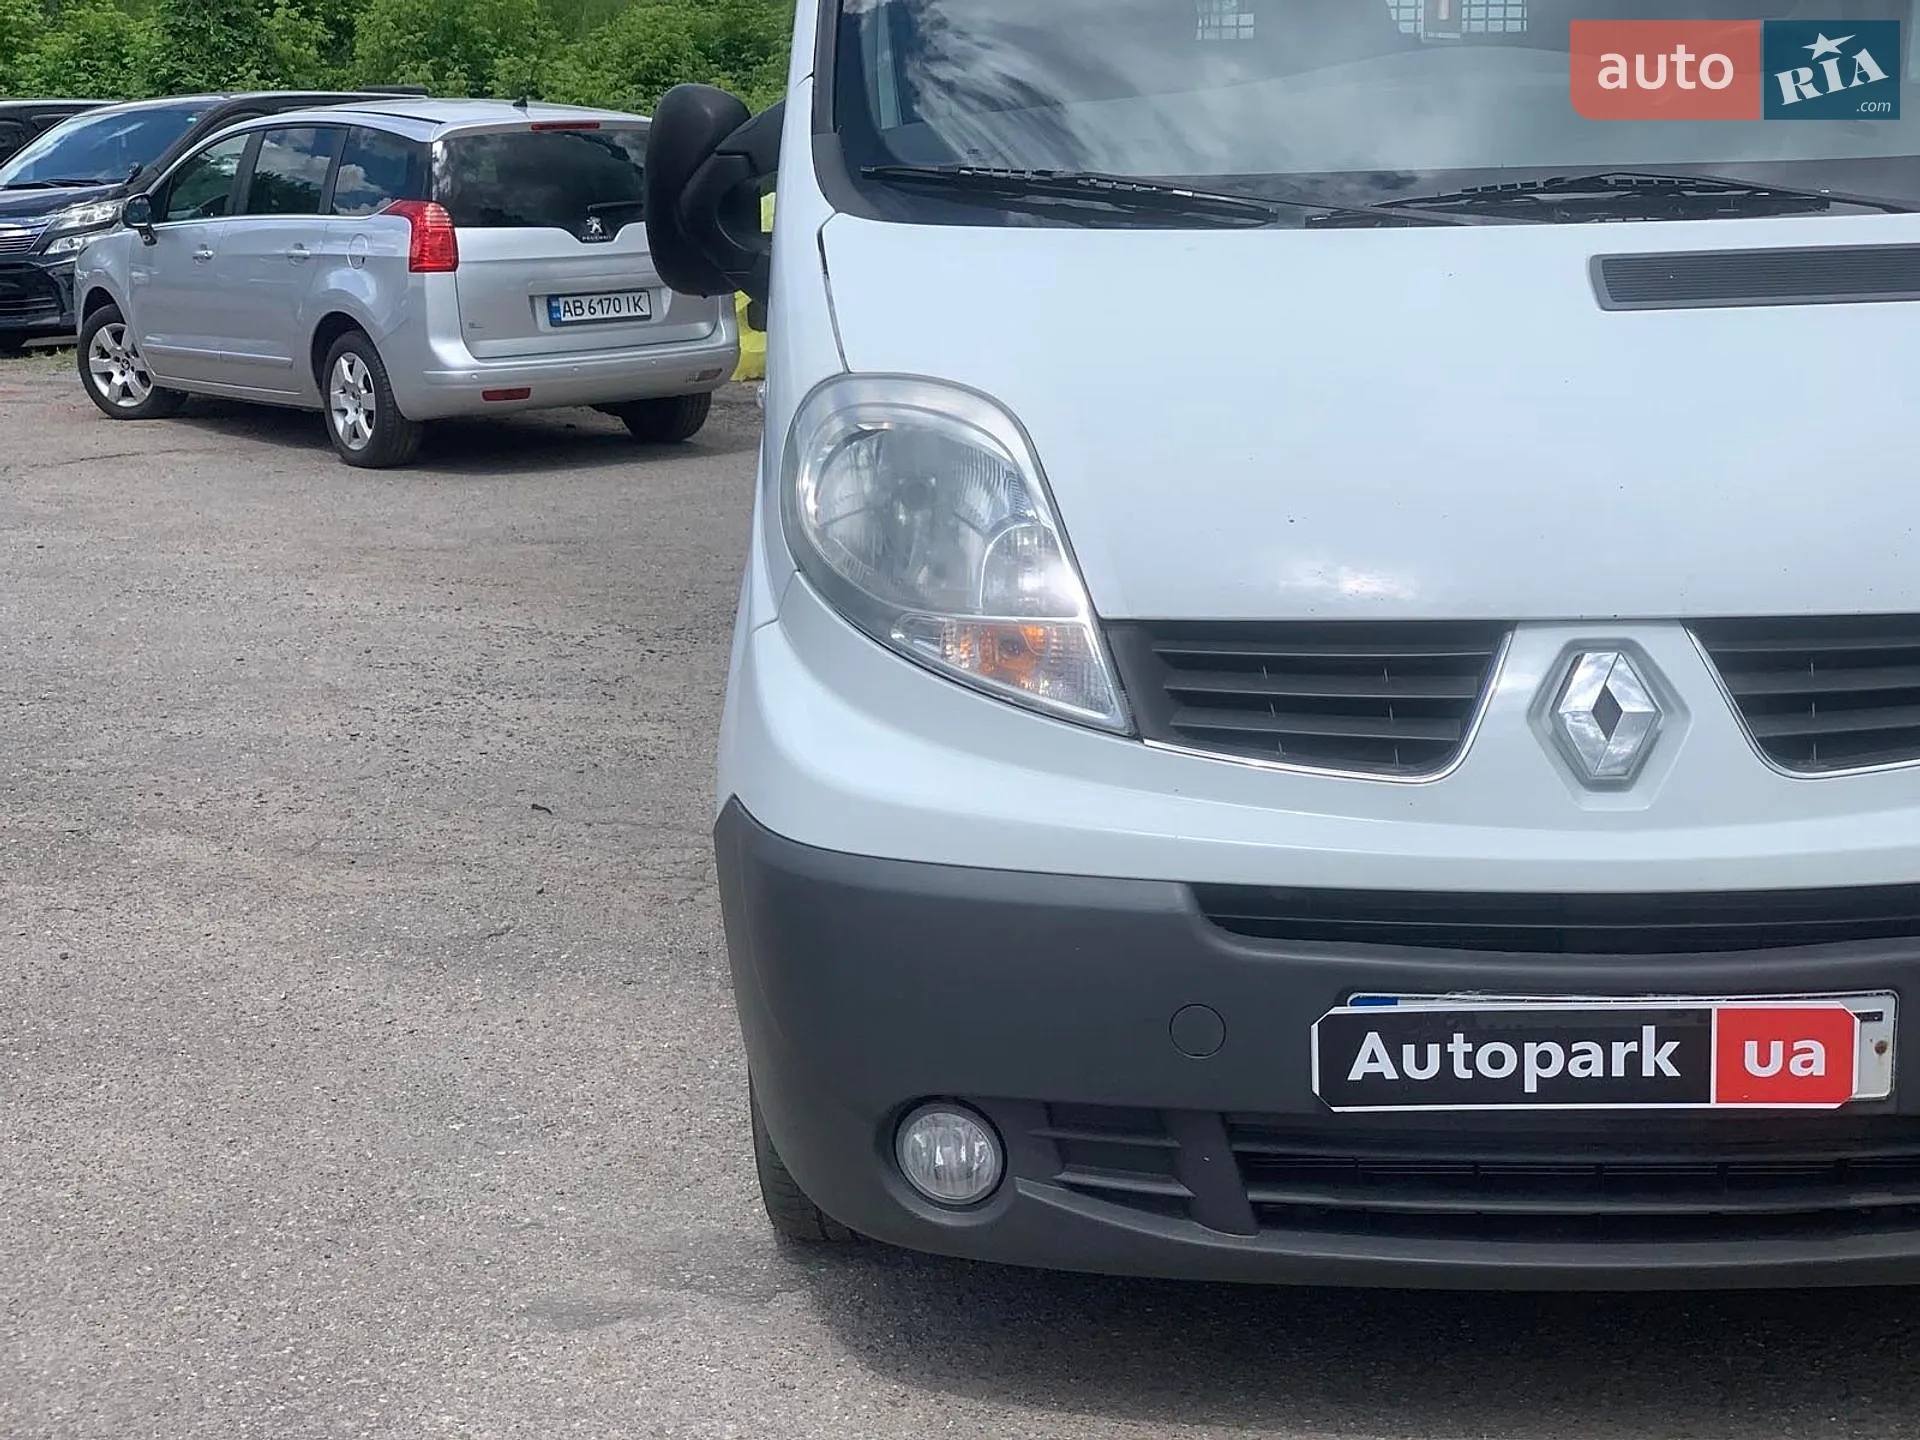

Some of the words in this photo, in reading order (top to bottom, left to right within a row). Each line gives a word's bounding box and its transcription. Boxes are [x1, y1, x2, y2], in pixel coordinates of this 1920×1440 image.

[562, 299, 585, 318] AB
[587, 297, 622, 316] 6170
[626, 294, 645, 313] IK
[1347, 1025, 1681, 1093] Autopark
[1743, 1039, 1826, 1077] ua
